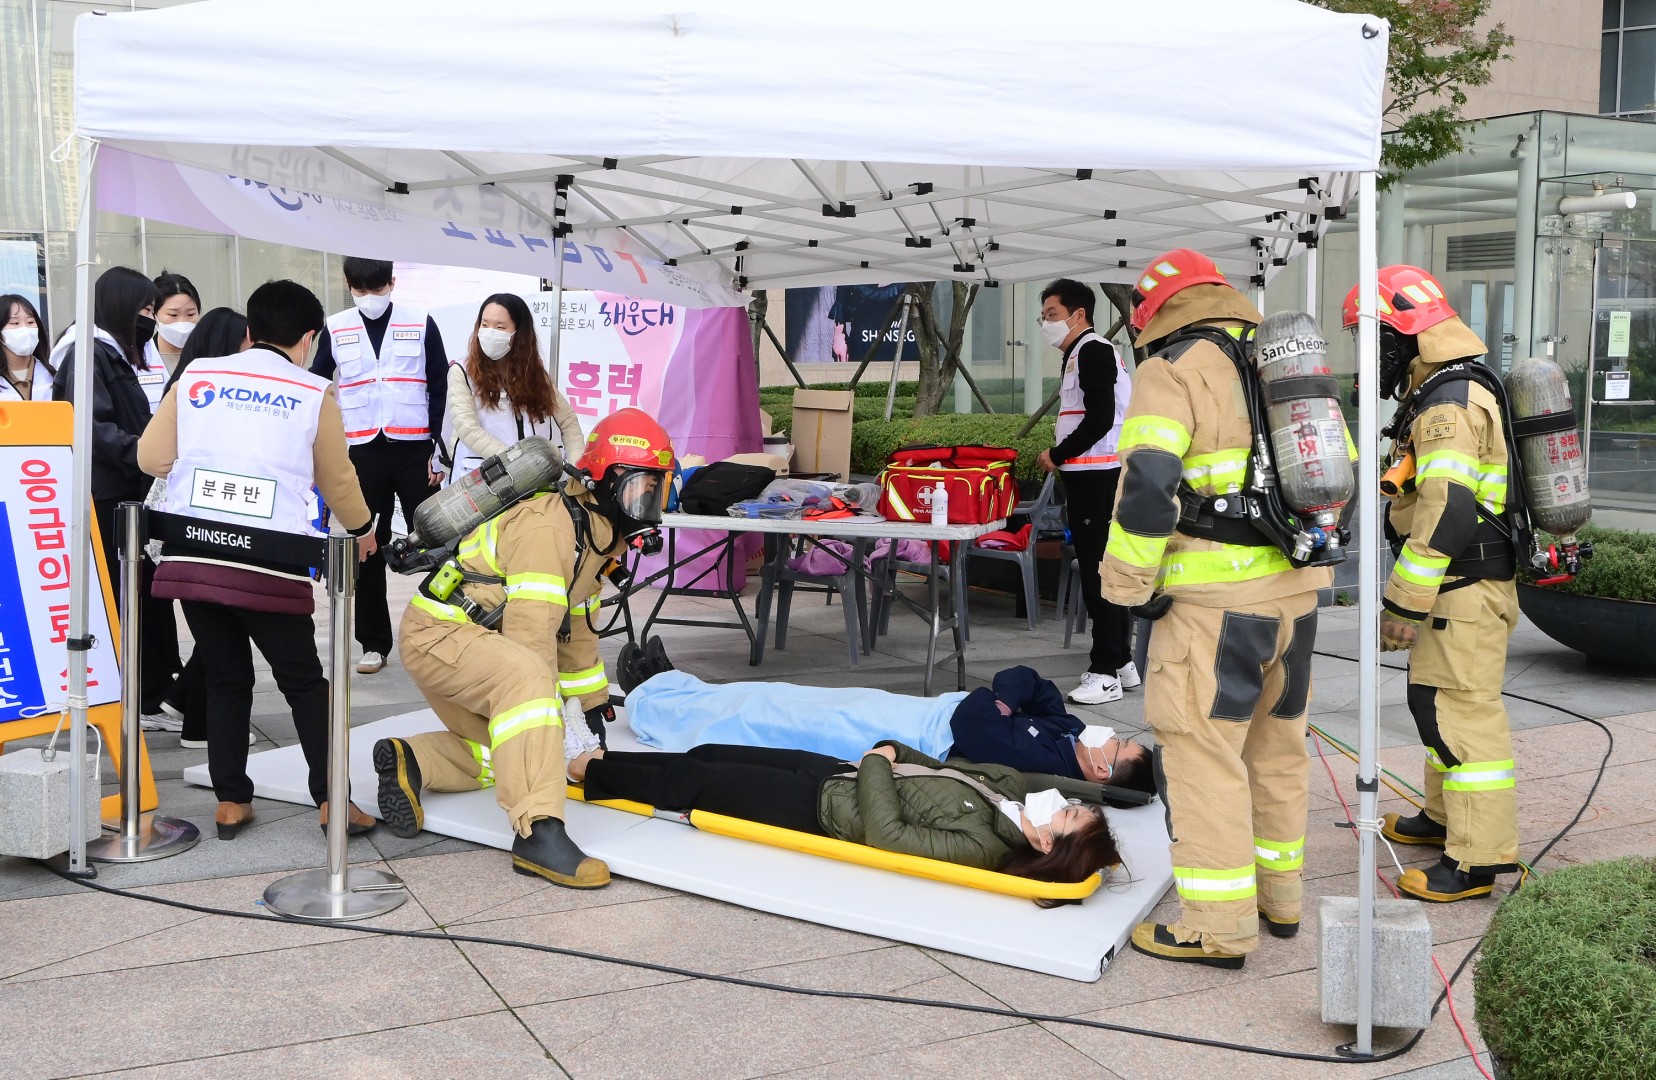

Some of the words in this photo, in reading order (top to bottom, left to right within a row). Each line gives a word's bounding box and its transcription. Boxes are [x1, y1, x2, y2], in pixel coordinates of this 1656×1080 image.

[532, 302, 549, 314] 살기
[570, 302, 587, 314] 도시
[599, 301, 674, 336] 해운대
[578, 319, 595, 330] 도시
[861, 329, 916, 342] SHNSG
[1261, 338, 1329, 361] SanCheon
[219, 386, 302, 411] KDMAT
[566, 361, 643, 417] 훈련
[202, 479, 261, 504] 분류반
[186, 525, 252, 549] SHINSEGAE
